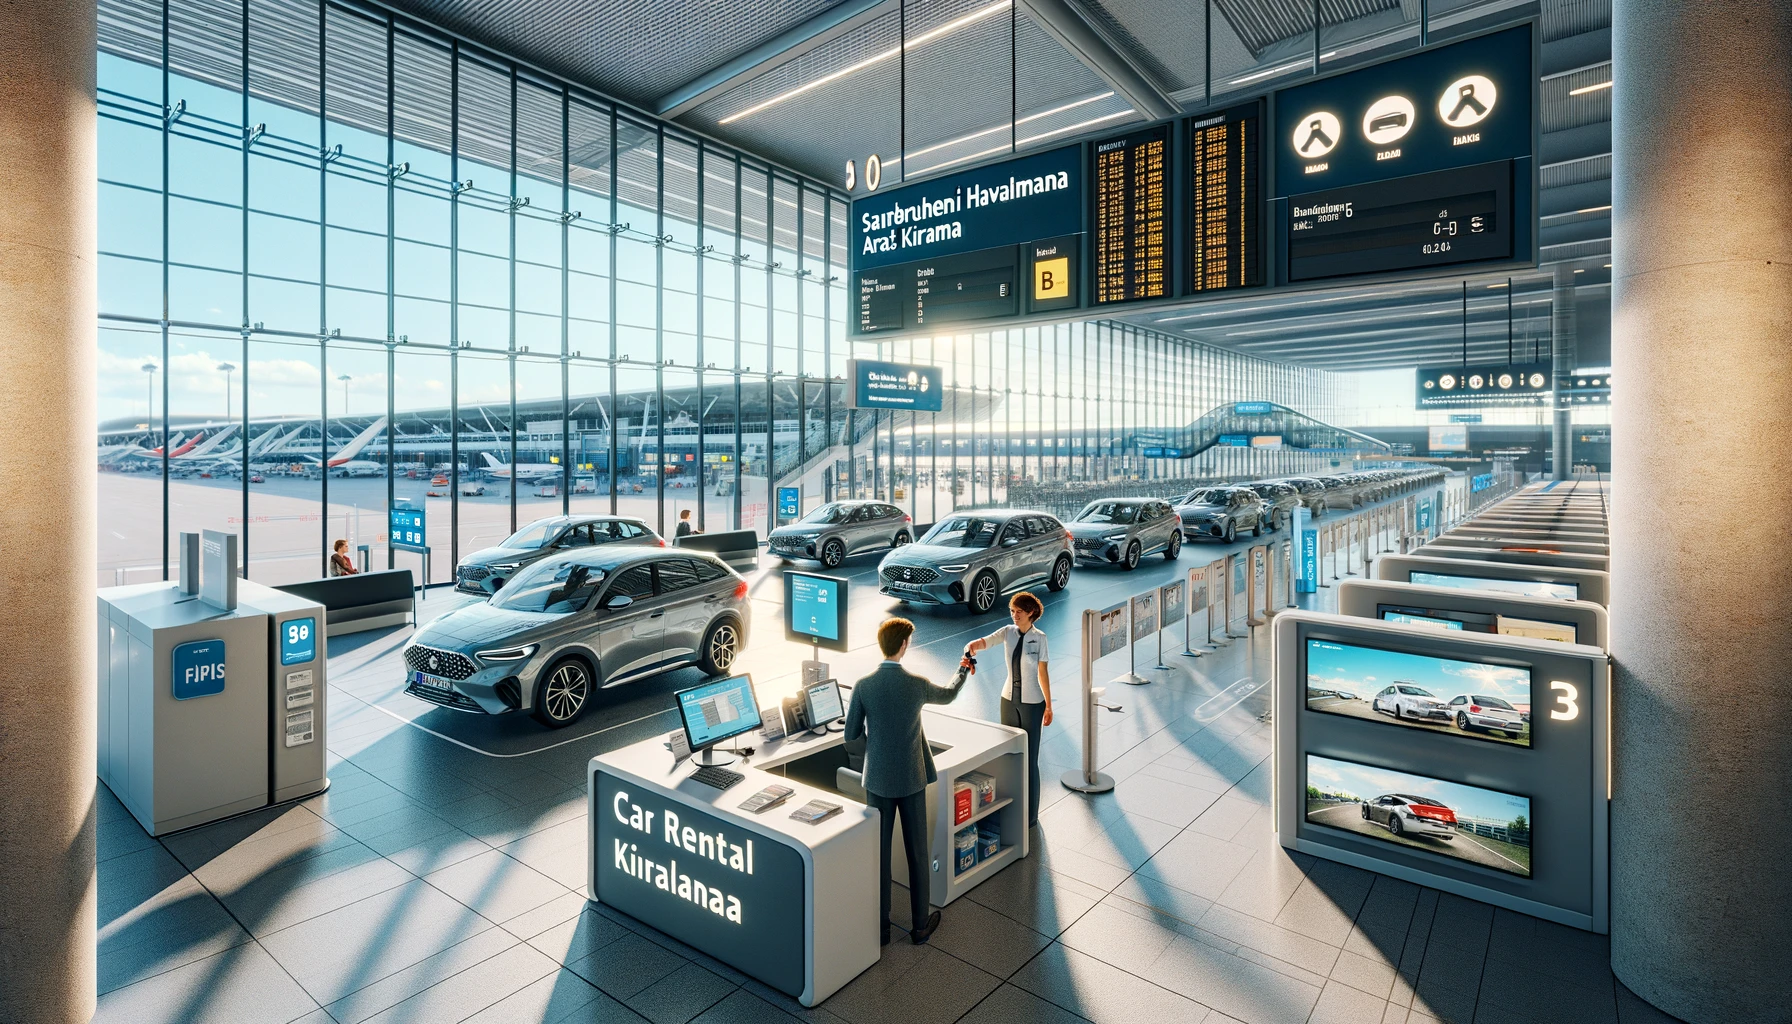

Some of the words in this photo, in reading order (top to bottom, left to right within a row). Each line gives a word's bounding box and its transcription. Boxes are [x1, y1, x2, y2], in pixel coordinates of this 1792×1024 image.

[901, 221, 962, 249] Kirama
[1041, 271, 1054, 290] B
[1549, 680, 1580, 722] 3
[613, 791, 655, 834] Car
[664, 809, 755, 875] Rental
